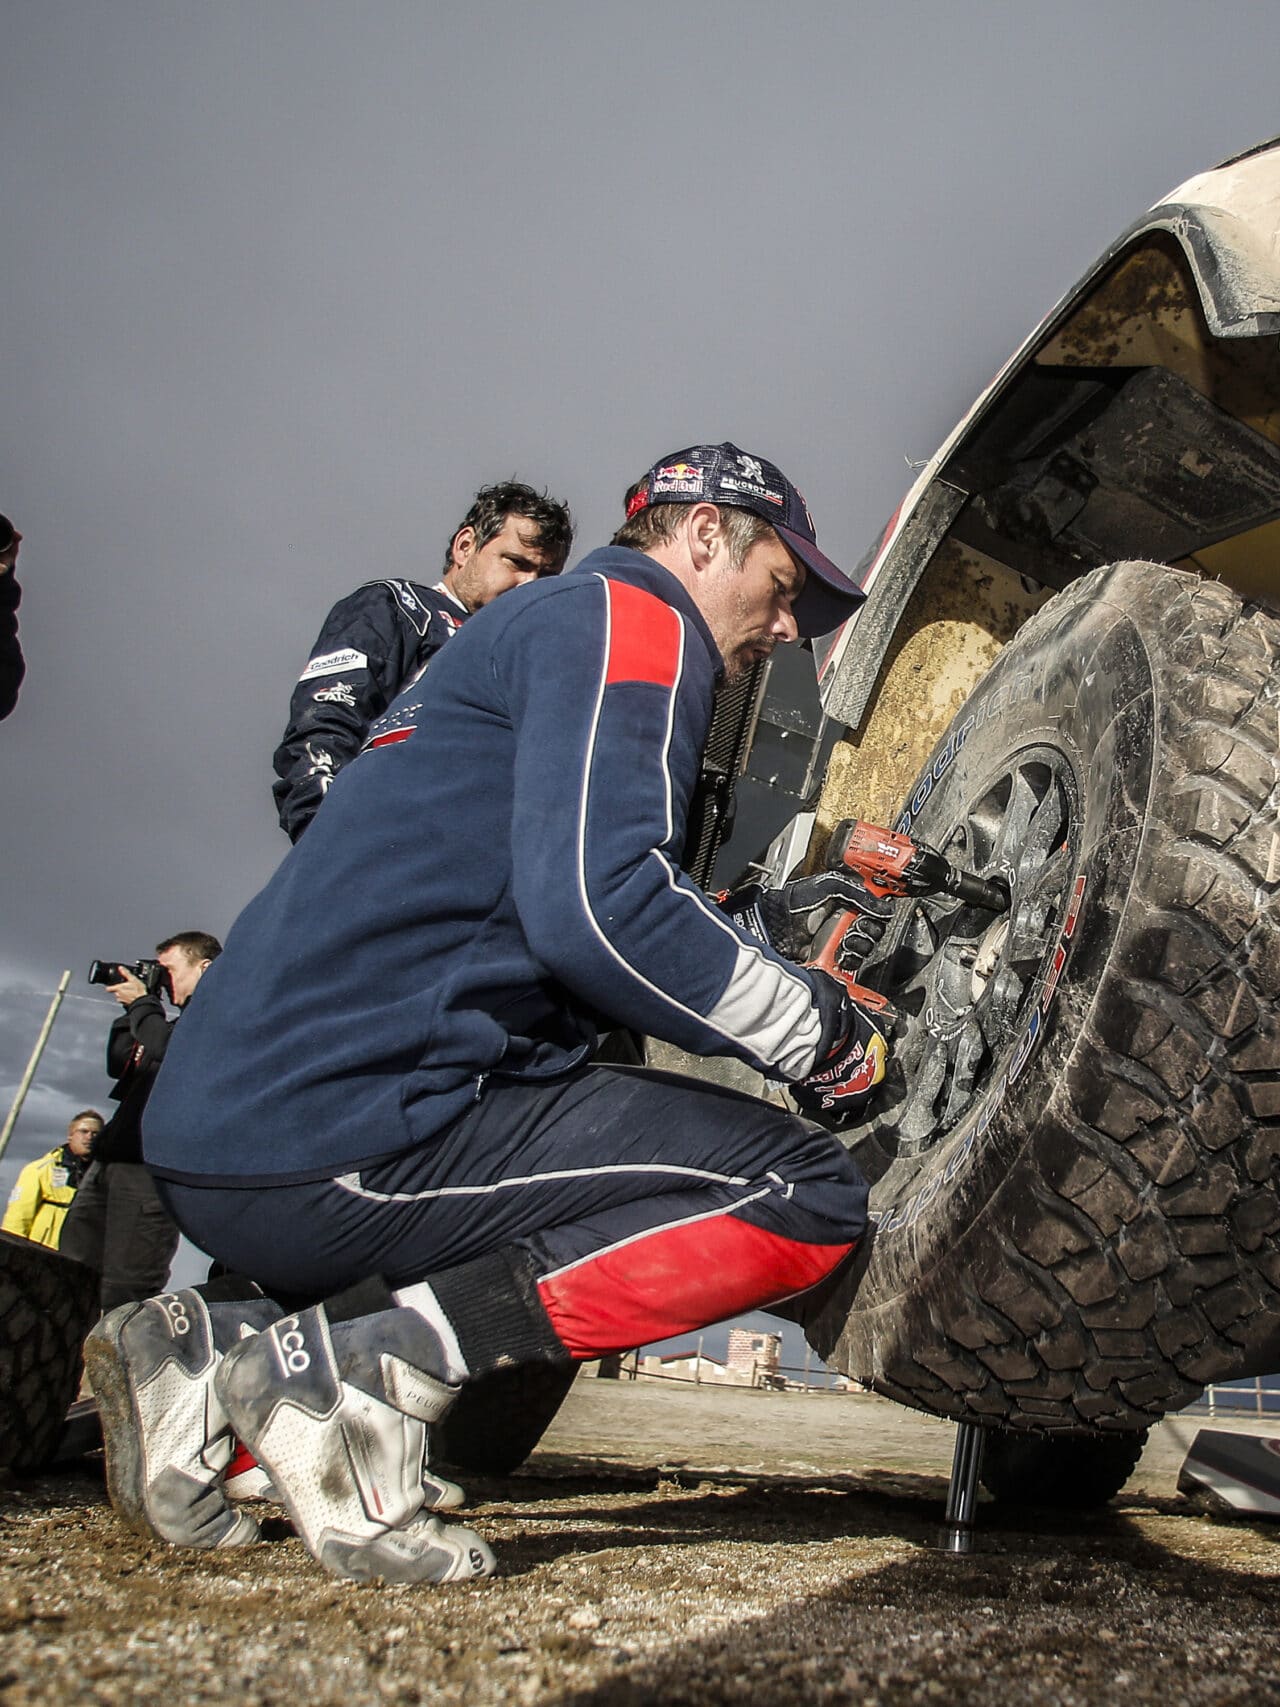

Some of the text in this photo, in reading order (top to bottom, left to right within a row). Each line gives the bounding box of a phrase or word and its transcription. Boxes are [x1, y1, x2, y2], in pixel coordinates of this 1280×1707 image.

[653, 479, 704, 494] Red Bull
[722, 477, 767, 495] PEUGEOT
